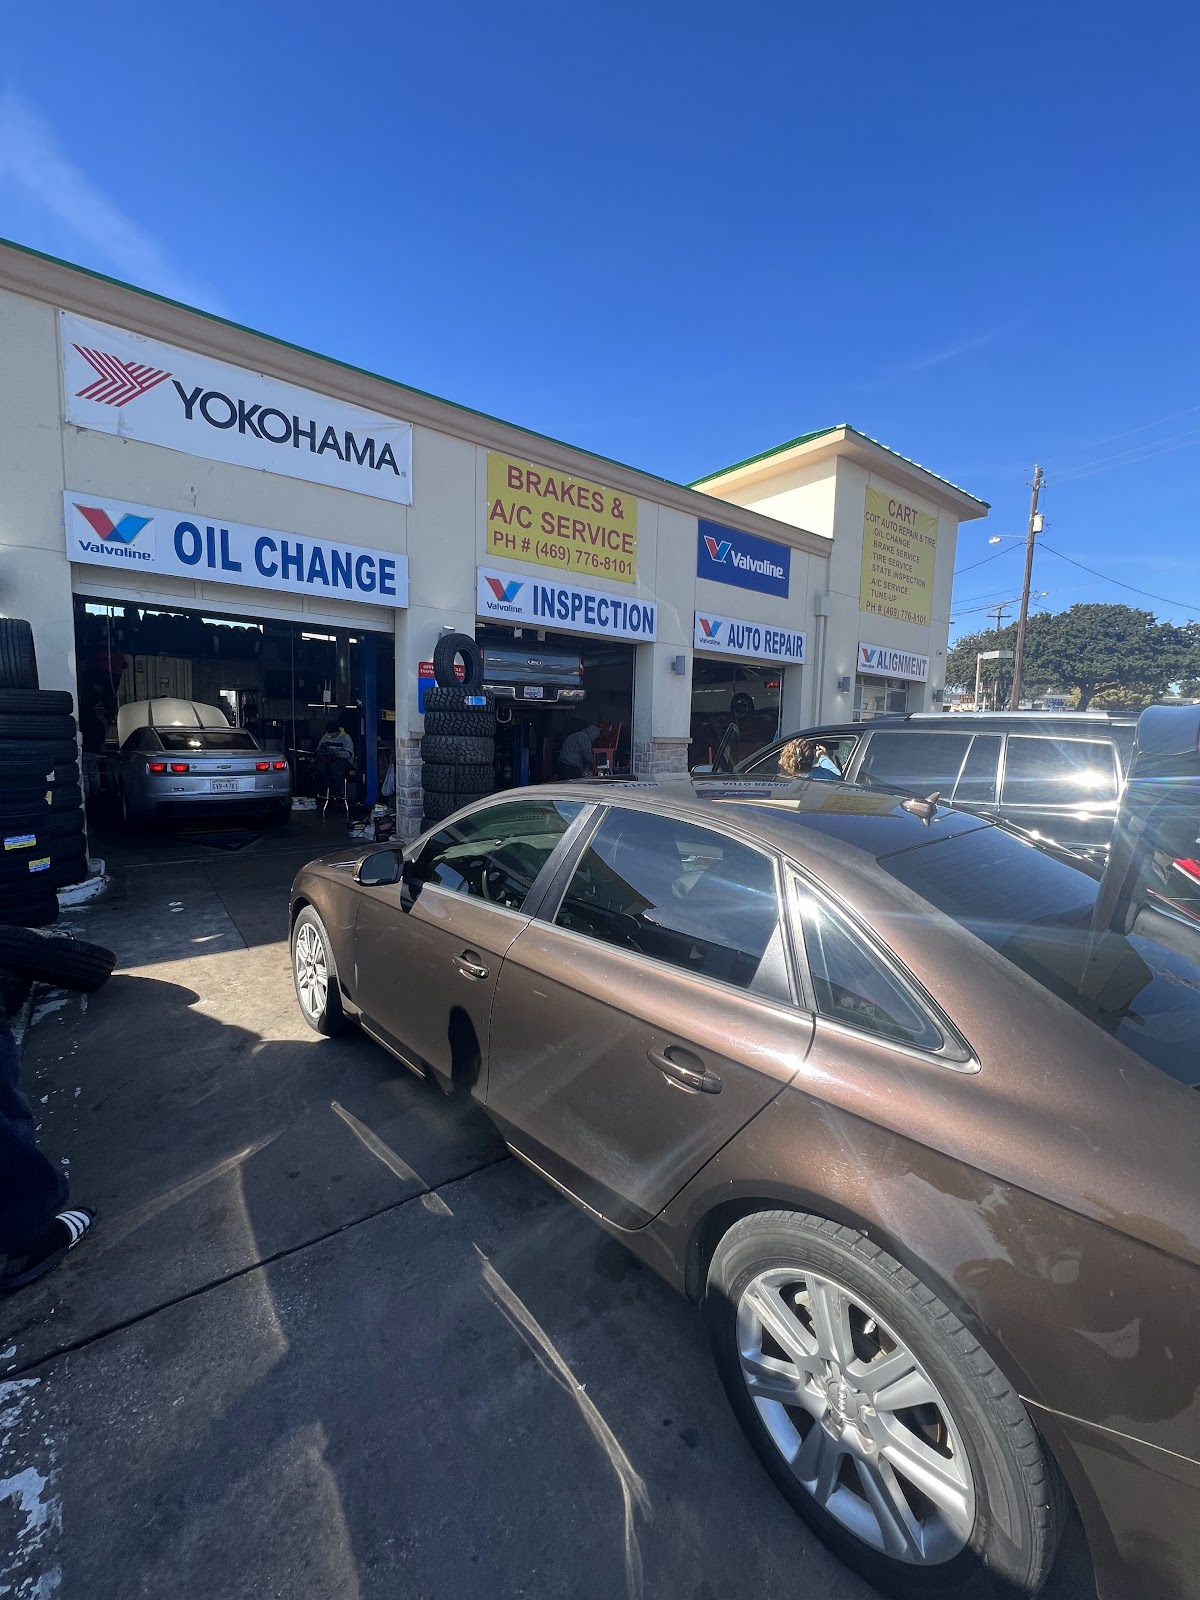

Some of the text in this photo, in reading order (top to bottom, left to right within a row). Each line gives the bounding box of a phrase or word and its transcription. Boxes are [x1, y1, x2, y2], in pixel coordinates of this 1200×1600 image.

[171, 379, 400, 476] YOKOHAMA
[507, 465, 624, 520] BRAKES &
[888, 500, 918, 526] CART
[489, 499, 634, 554] A/C SERVICE
[881, 518, 897, 532] AUTO
[899, 525, 918, 541] REPAIR
[924, 536, 936, 548] TIRE
[78, 539, 153, 561] Valvoline
[493, 531, 632, 575] PH # (469) 776-8101
[886, 533, 911, 549] CHANGE
[173, 521, 397, 596] OIL CHANGE
[731, 550, 784, 579] Valvoline
[888, 558, 913, 573] SERVICE
[896, 549, 920, 564] SERVICE
[884, 581, 908, 595] SERVICE
[893, 571, 926, 588] INSPECTION
[486, 601, 523, 614] Valvoline
[533, 585, 654, 634] INSPECTION
[866, 601, 876, 612] PH
[901, 610, 926, 625] 776-8101
[727, 623, 803, 658] AUTO REPAIR
[876, 650, 927, 676] ALIGNMENT
